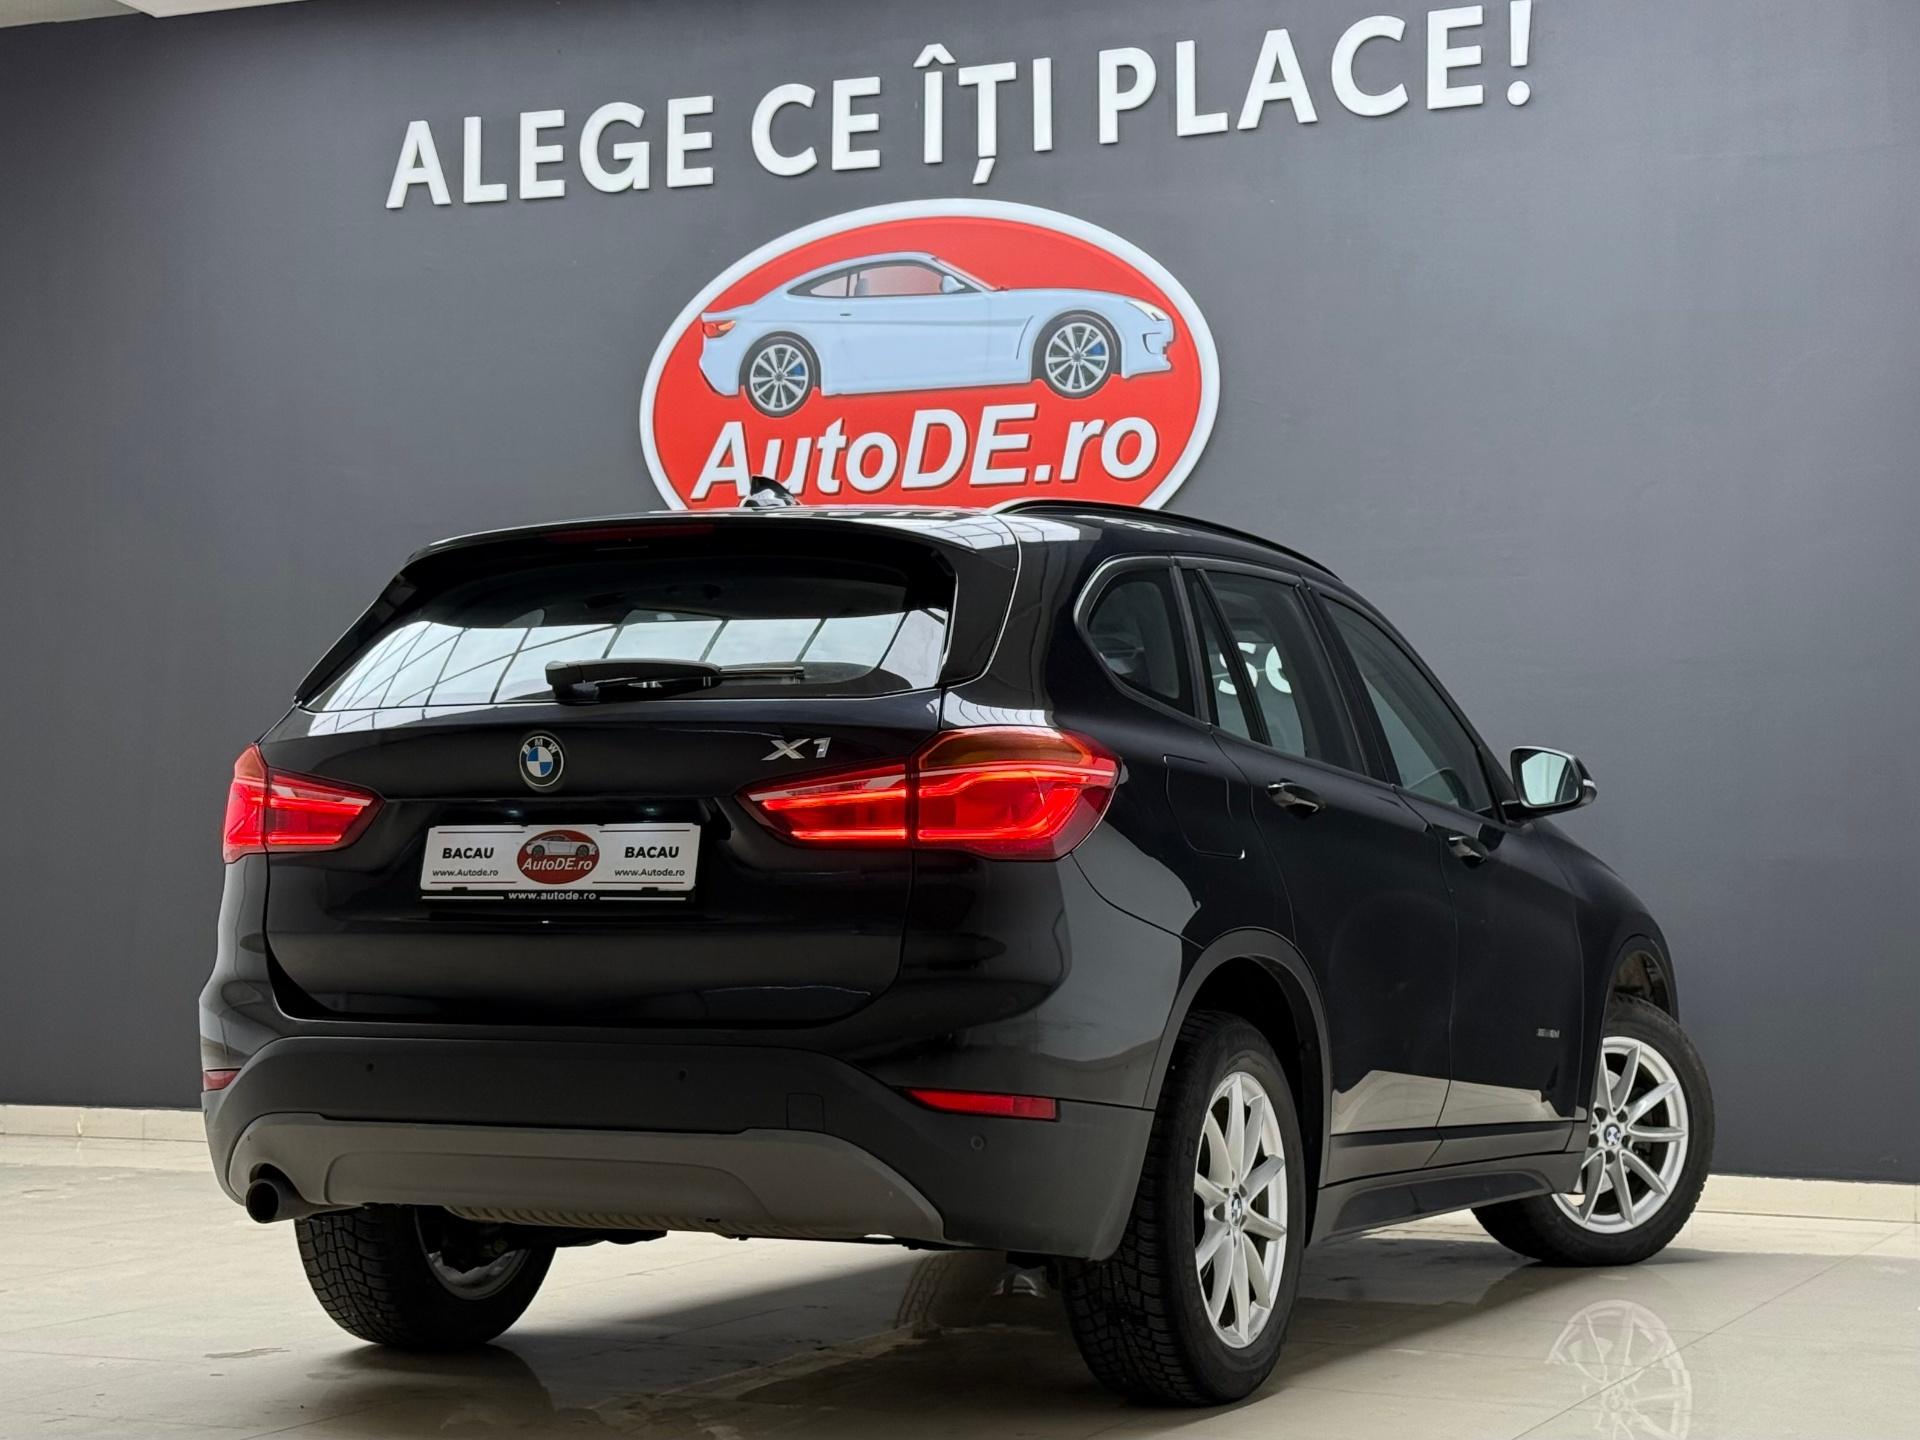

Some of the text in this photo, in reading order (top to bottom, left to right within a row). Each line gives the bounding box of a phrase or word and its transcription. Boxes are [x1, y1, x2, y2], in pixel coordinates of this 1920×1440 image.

[385, 0, 1533, 209] ALEGE CE ÎȚI PLACE!
[690, 403, 1160, 502] AutoDE.ro
[760, 737, 832, 761] X1
[441, 847, 495, 859] BACAU
[623, 846, 680, 859] BACAU
[521, 857, 593, 871] AutoDE.ro
[432, 867, 499, 877] www.Autode.ro
[614, 867, 685, 877] www.Autode.ro
[507, 890, 597, 901] www.autode.ro
